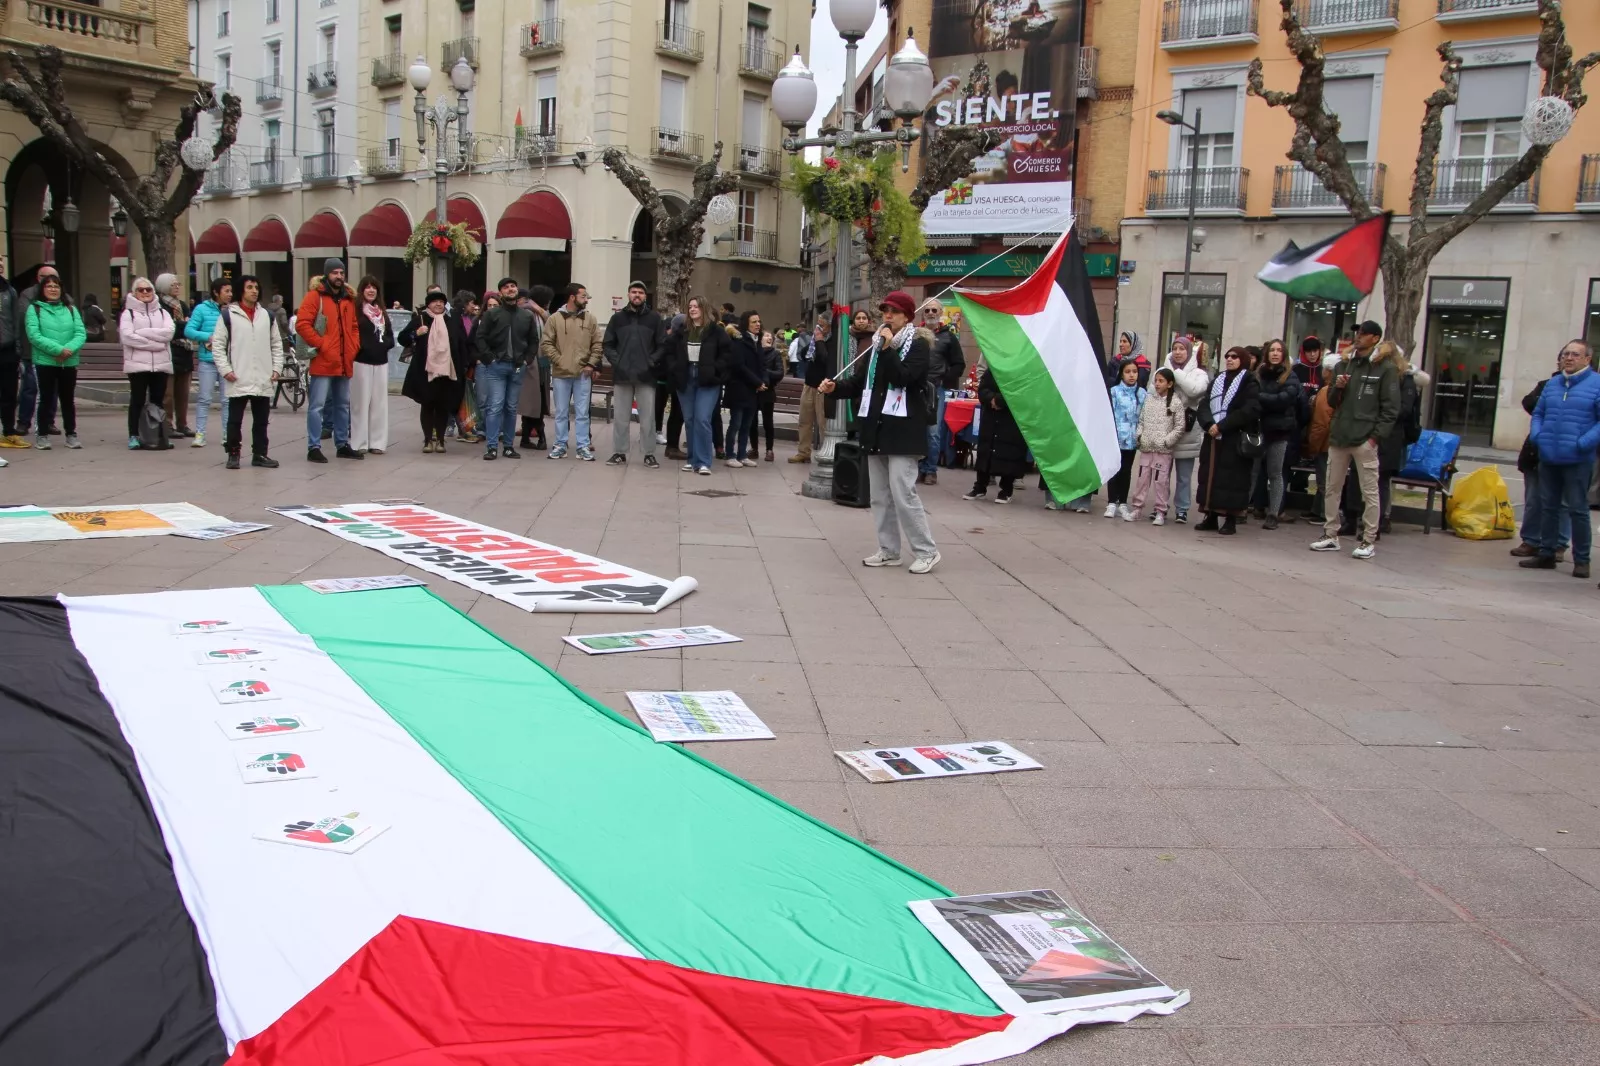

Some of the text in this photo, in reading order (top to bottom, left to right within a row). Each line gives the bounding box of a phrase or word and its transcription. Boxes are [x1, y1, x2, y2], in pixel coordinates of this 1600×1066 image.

[935, 91, 1059, 126] SIENTE.
[992, 125, 1031, 134] OMERCIO
[1032, 123, 1056, 132] LOCAL
[1028, 157, 1062, 165] COMERCIO
[1028, 165, 1060, 173] HUESCA
[974, 194, 1061, 204] VISA HUESCA, consigue
[950, 208, 971, 217] tarjeta
[972, 207, 984, 216] del
[985, 207, 1019, 215] Comercio
[1020, 206, 1030, 214] de
[1031, 206, 1060, 214] Huesca.
[930, 259, 968, 267] CAJA RURAL
[334, 523, 405, 539] CON
[351, 508, 633, 583] PALESTINA
[389, 541, 537, 586] HUESCA
